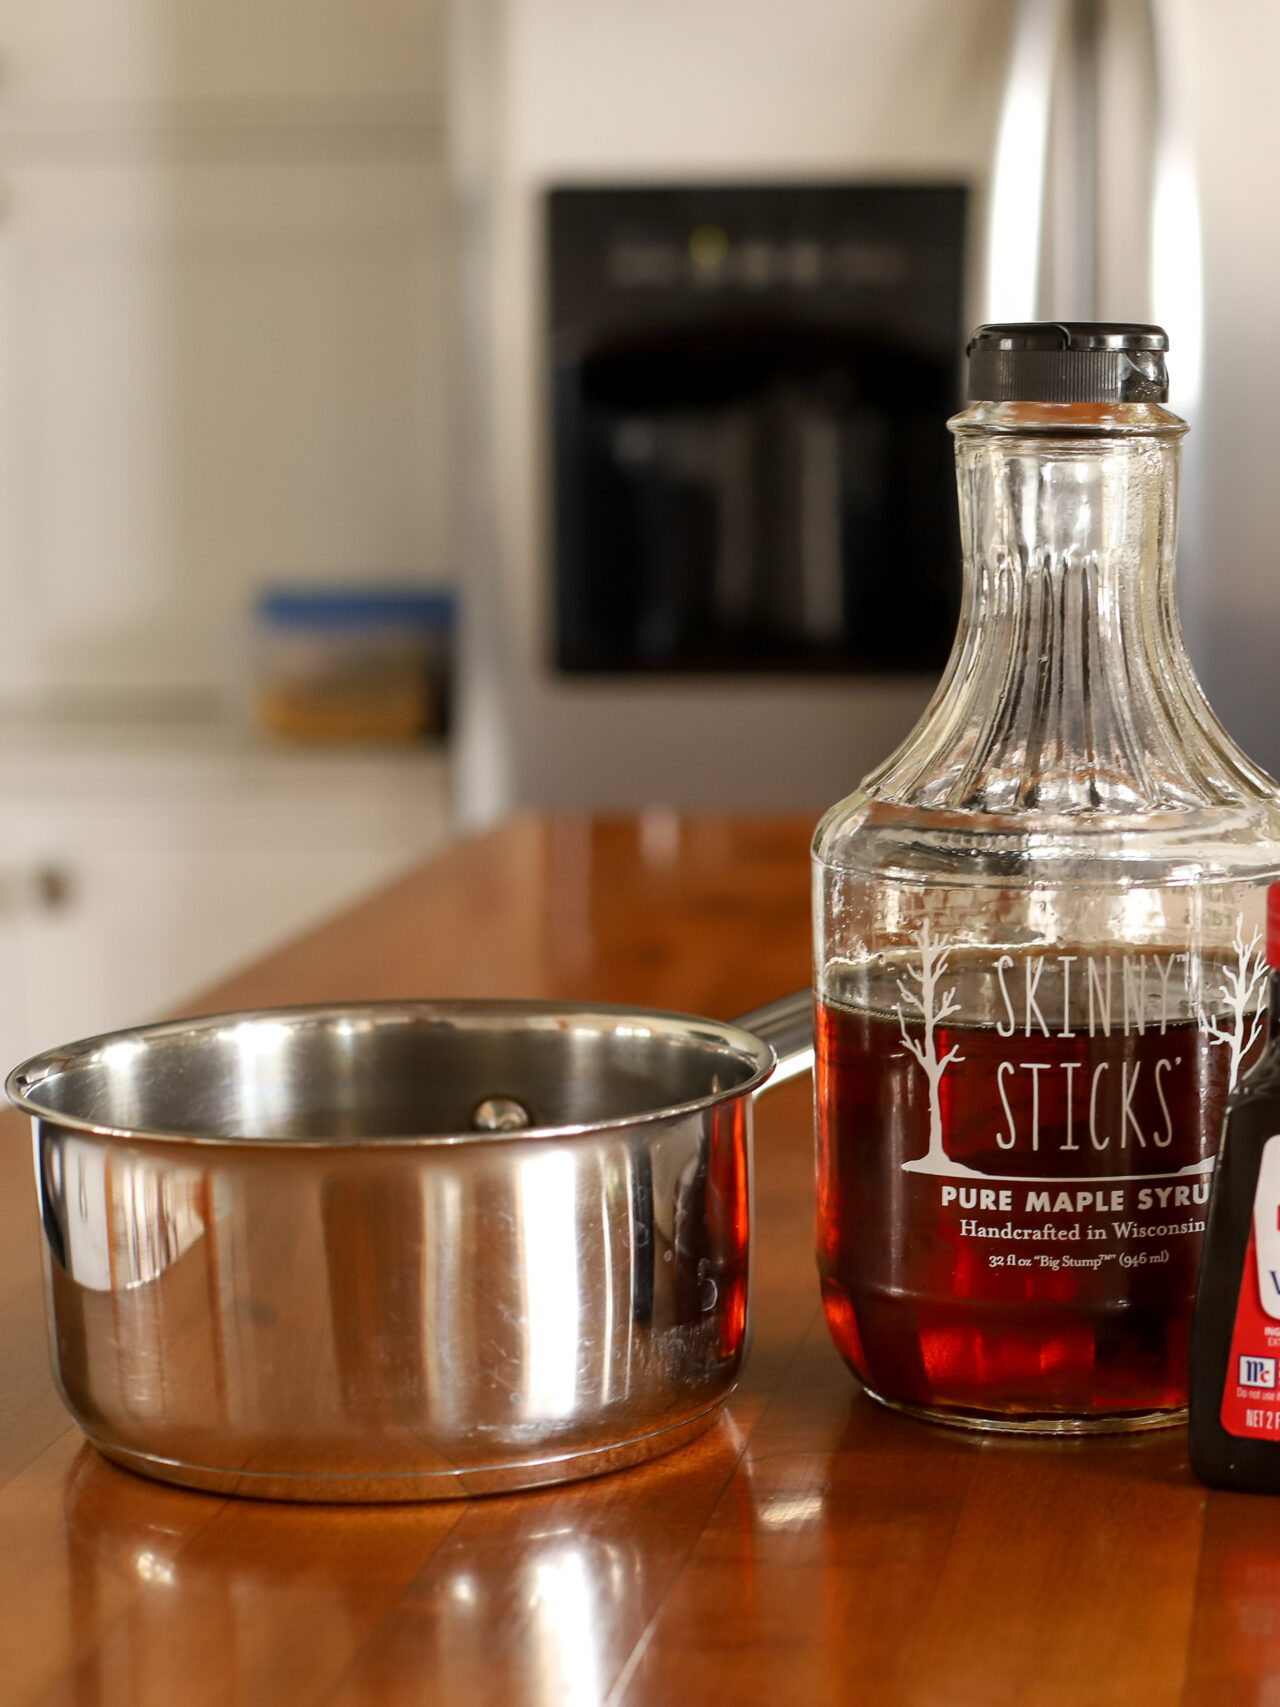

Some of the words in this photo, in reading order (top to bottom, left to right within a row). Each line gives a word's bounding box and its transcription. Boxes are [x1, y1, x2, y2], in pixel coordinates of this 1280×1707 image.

[941, 1185, 1012, 1211] PURE
[1025, 1190, 1125, 1212] MAPLE
[1137, 1183, 1210, 1209] SYRU
[959, 1219, 1080, 1240] Handcrafted
[1087, 1225, 1107, 1240] in
[1112, 1218, 1206, 1239] Wisconsin
[989, 1255, 1004, 1267] 32
[1006, 1254, 1017, 1266] fl
[1018, 1257, 1032, 1267] oz
[1119, 1251, 1147, 1268] (946
[1149, 1249, 1170, 1264] ml)
[1246, 1409, 1263, 1428] NET
[1266, 1411, 1273, 1429] 2
